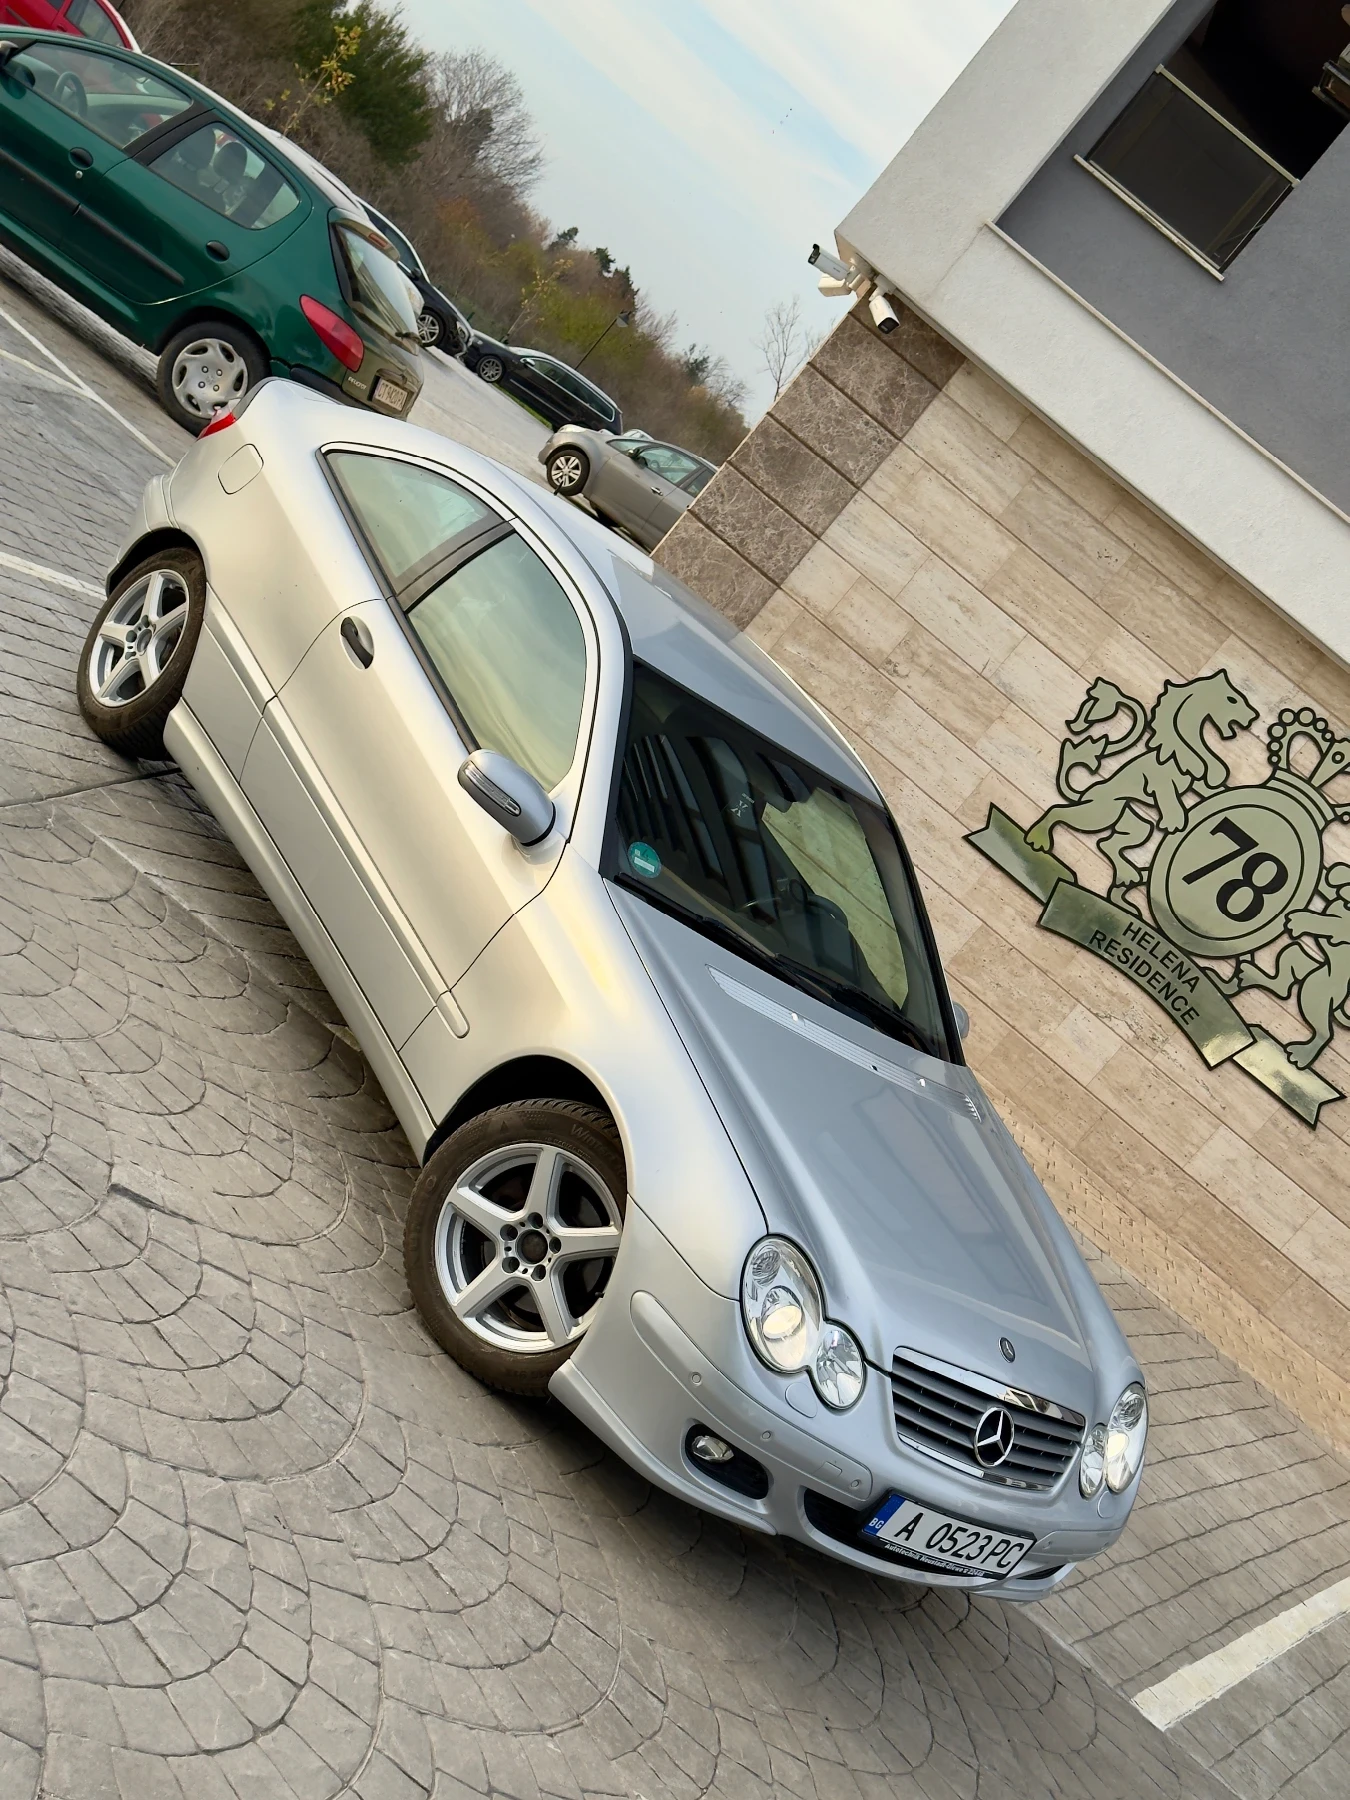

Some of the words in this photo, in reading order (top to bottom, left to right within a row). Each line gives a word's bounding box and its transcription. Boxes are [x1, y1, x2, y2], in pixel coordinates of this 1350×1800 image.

[1181, 816, 1289, 923] 78
[1088, 929, 1200, 1026] RESIDENCE
[1121, 921, 1201, 994] HELENA
[868, 1517, 885, 1529] BG
